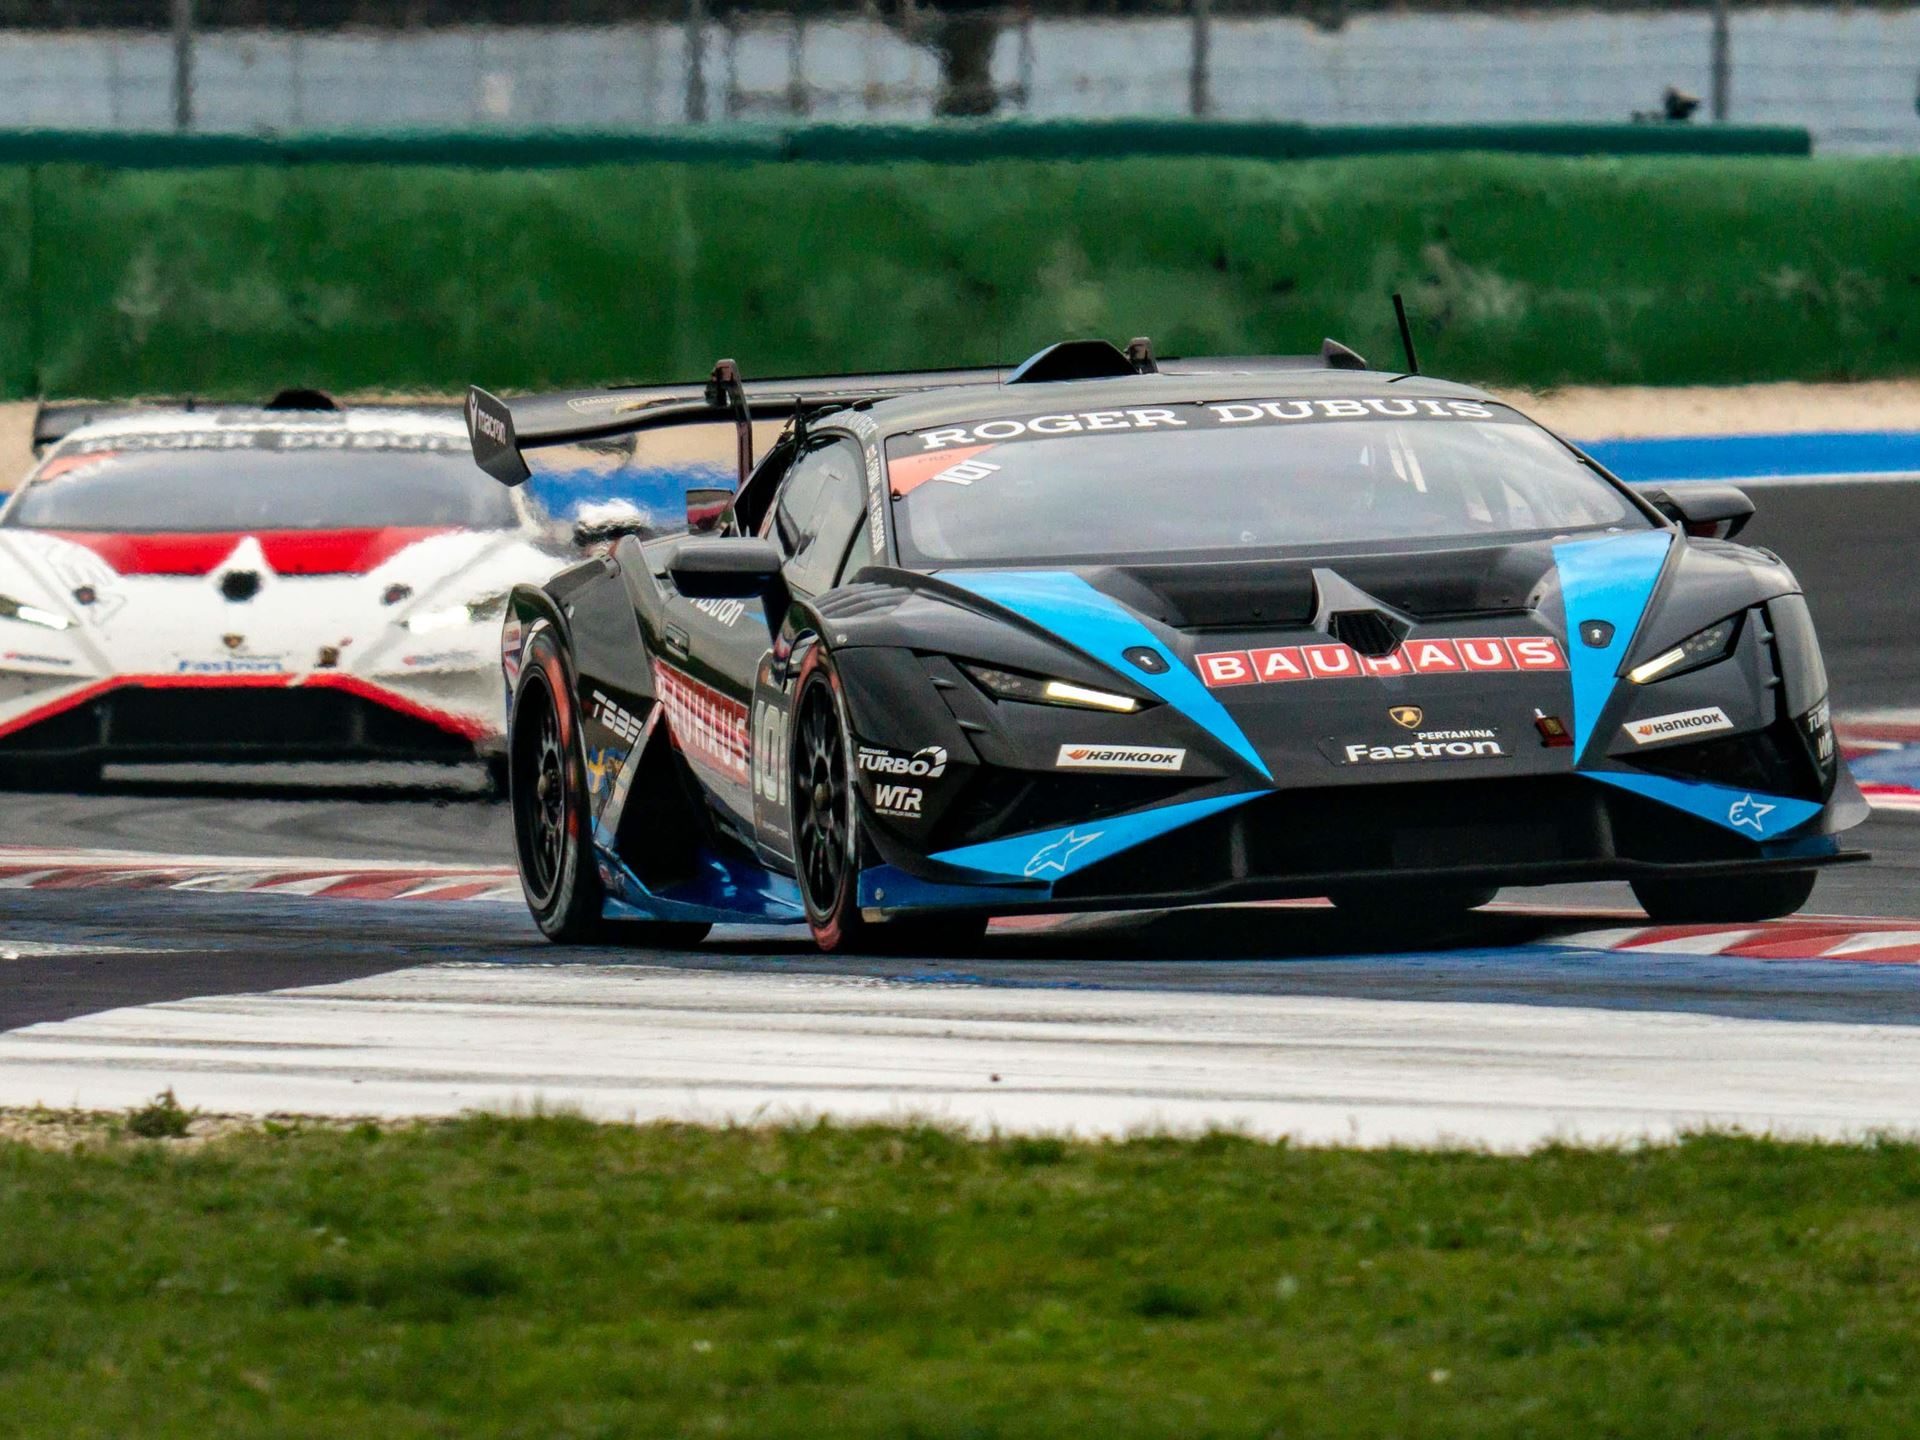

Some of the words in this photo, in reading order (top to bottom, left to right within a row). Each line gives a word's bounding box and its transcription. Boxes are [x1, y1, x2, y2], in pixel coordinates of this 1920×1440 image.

[919, 406, 1188, 449] ROGER
[1209, 399, 1493, 424] DUBUIS
[932, 460, 1001, 486] 101
[1207, 641, 1557, 680] BAUHAUS
[1417, 729, 1496, 740] PERTAMINA
[754, 699, 789, 806] 101
[1345, 740, 1501, 762] Fastron
[858, 754, 930, 776] TURBO
[875, 783, 924, 811] WTR
